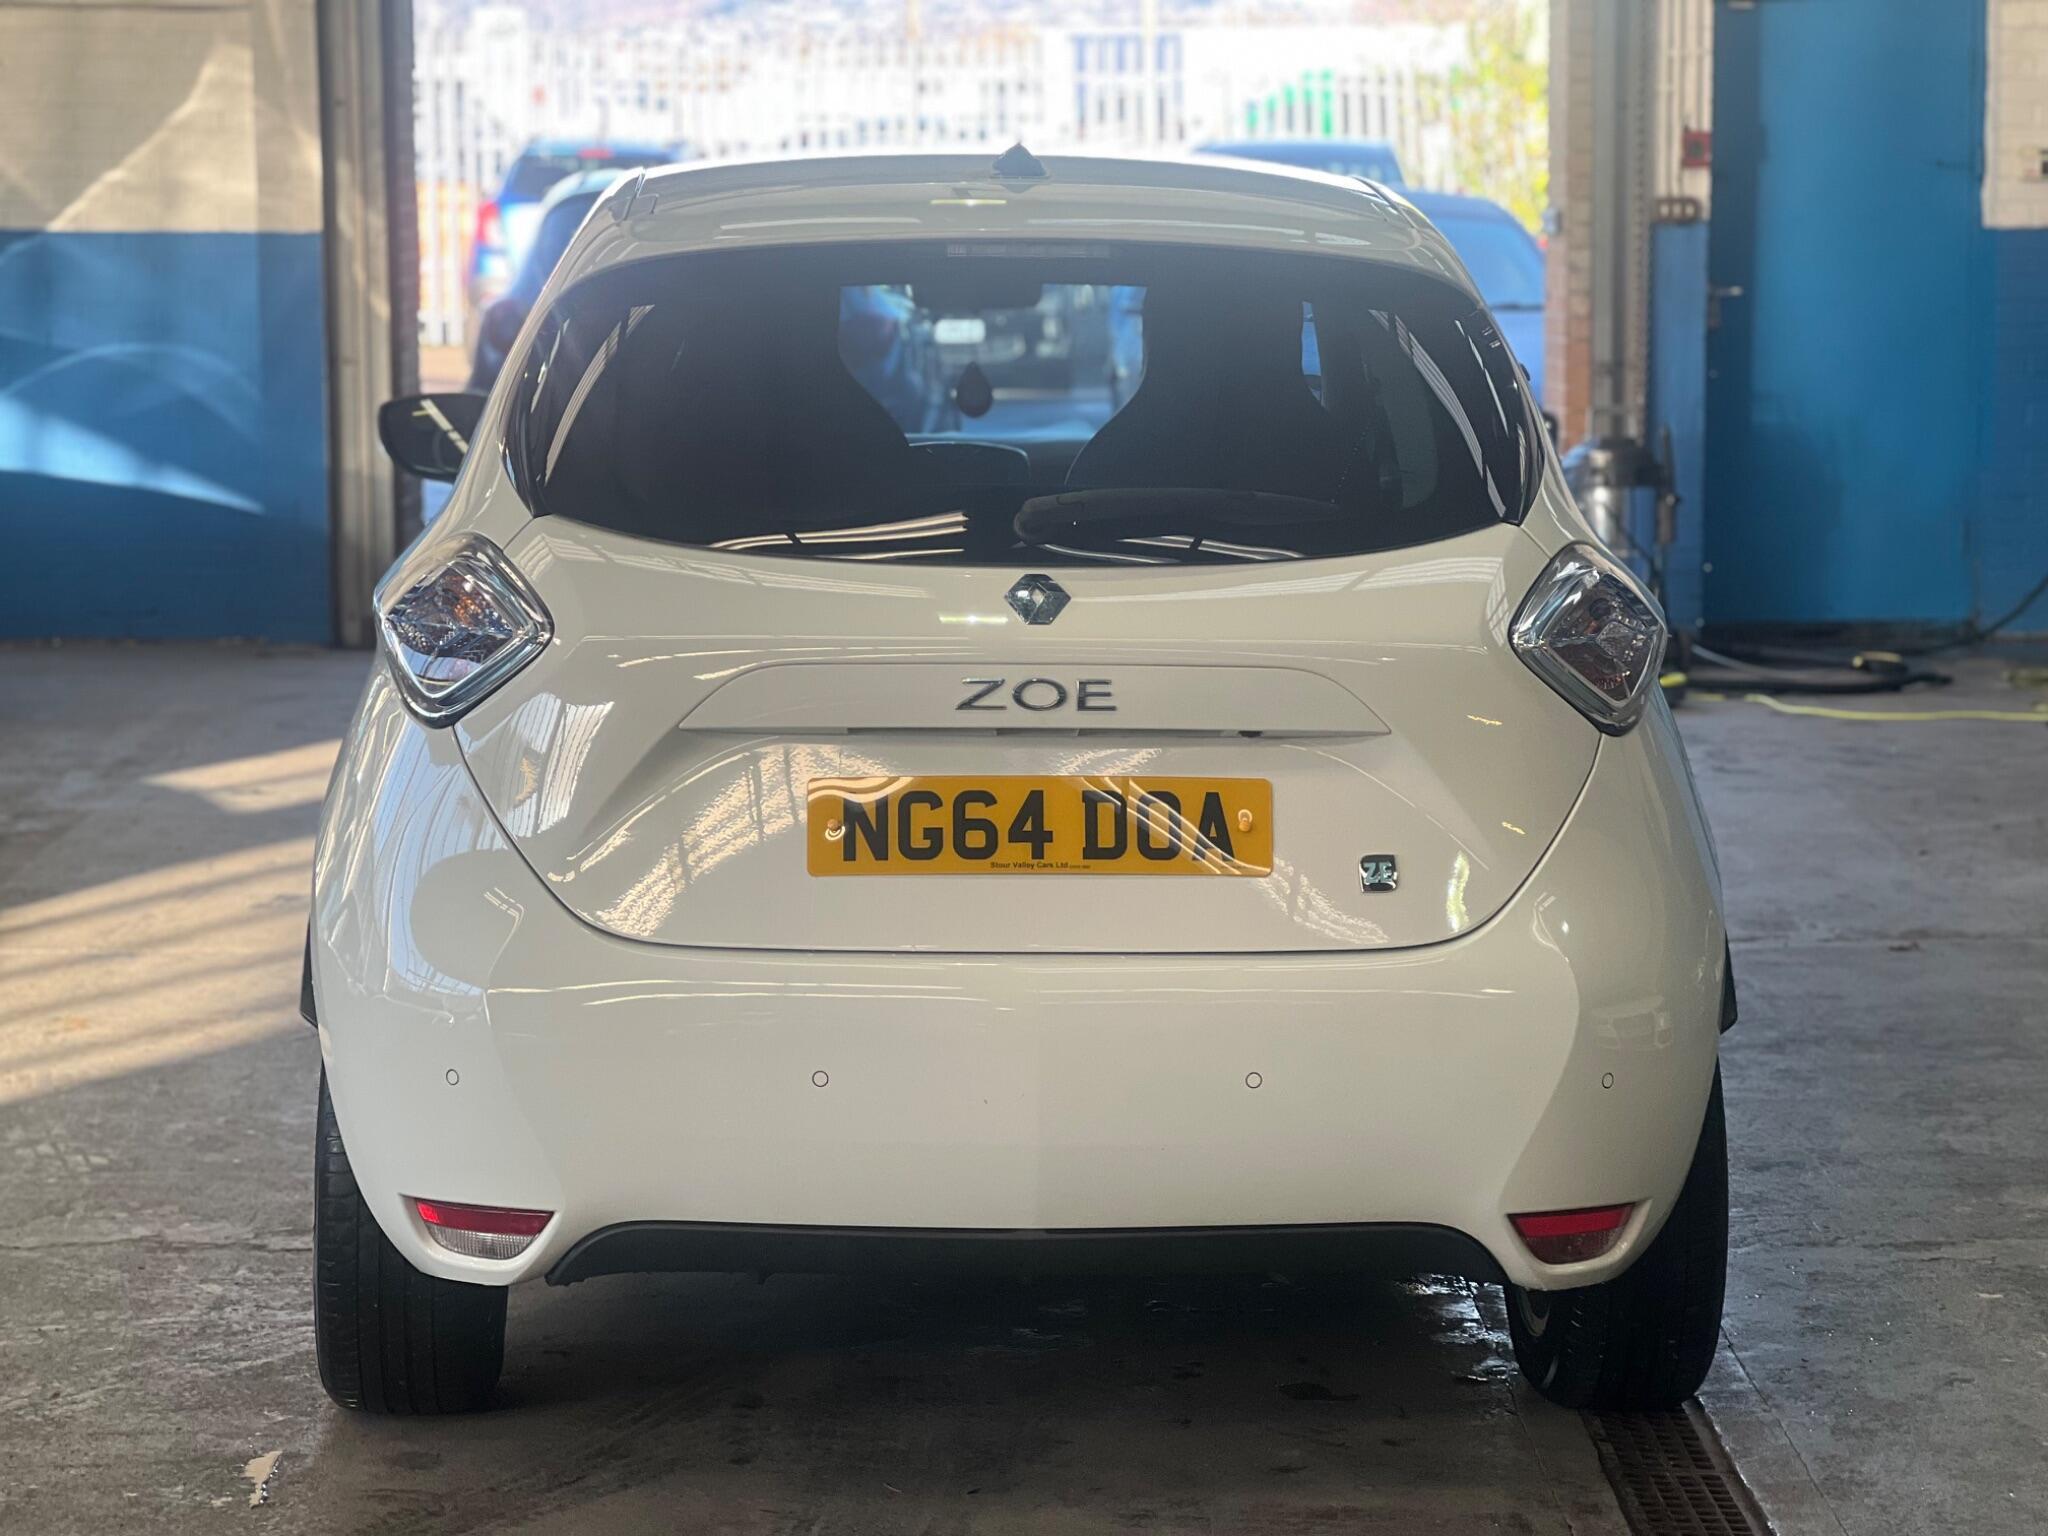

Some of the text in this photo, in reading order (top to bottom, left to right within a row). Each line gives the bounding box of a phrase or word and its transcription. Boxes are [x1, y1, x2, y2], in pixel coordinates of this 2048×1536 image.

[955, 678, 1117, 712] ZOE
[843, 790, 1235, 861] NG64 DOA
[1013, 861, 1035, 870] Valley
[1036, 861, 1053, 869] Cars
[1055, 861, 1068, 869] Ltd
